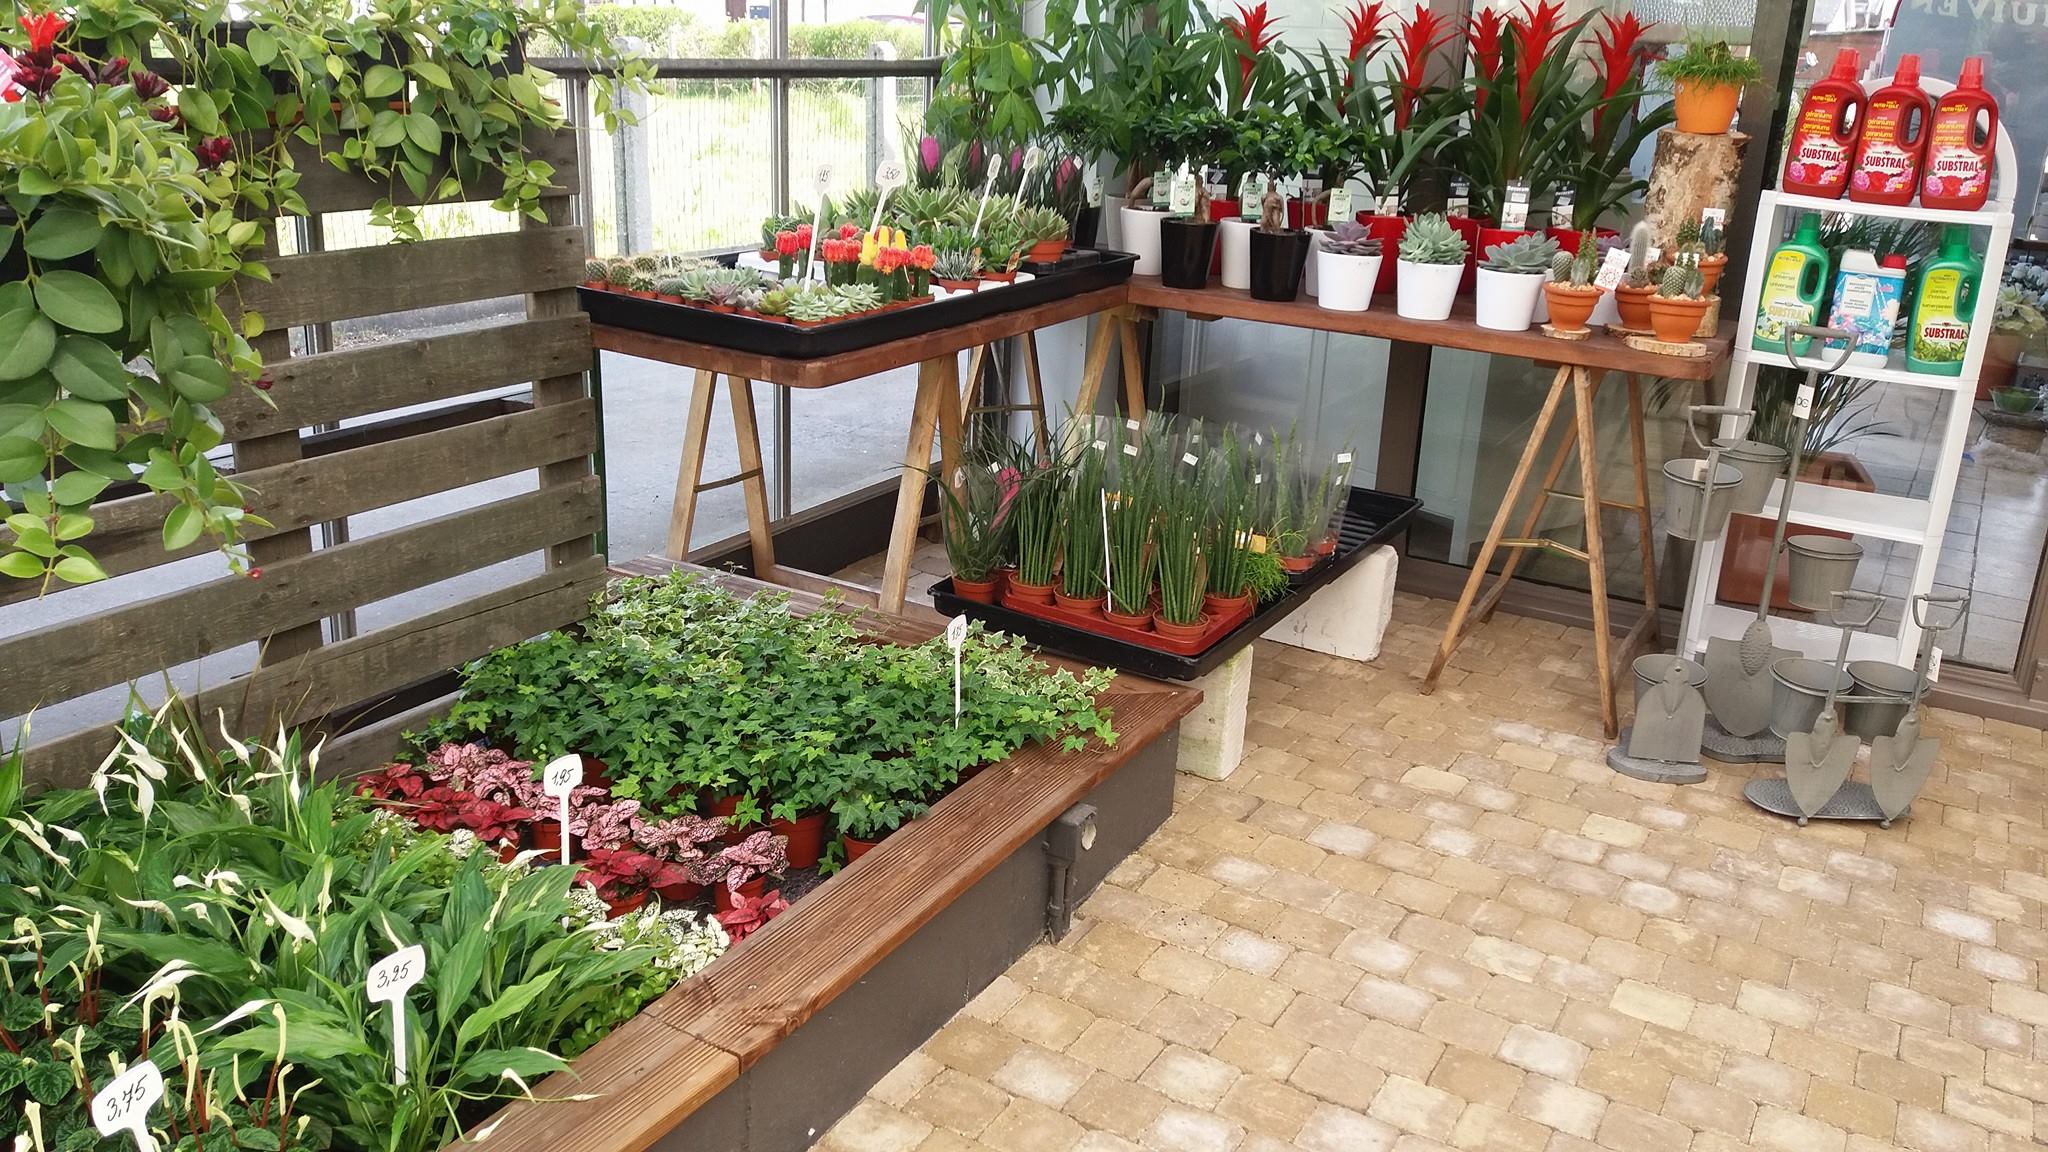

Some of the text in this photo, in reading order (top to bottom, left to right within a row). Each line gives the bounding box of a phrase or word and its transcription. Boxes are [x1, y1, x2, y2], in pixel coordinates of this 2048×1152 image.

[1801, 147, 1841, 162] SUBSTRAL
[1865, 155, 1906, 169] SUBSTRAL
[1936, 160, 1978, 172] SUBSTRAL
[1924, 327, 1965, 339] SUBSTRAL
[552, 768, 574, 786] 1,95
[377, 960, 412, 988] 3,25
[106, 1073, 148, 1122] 3,75
